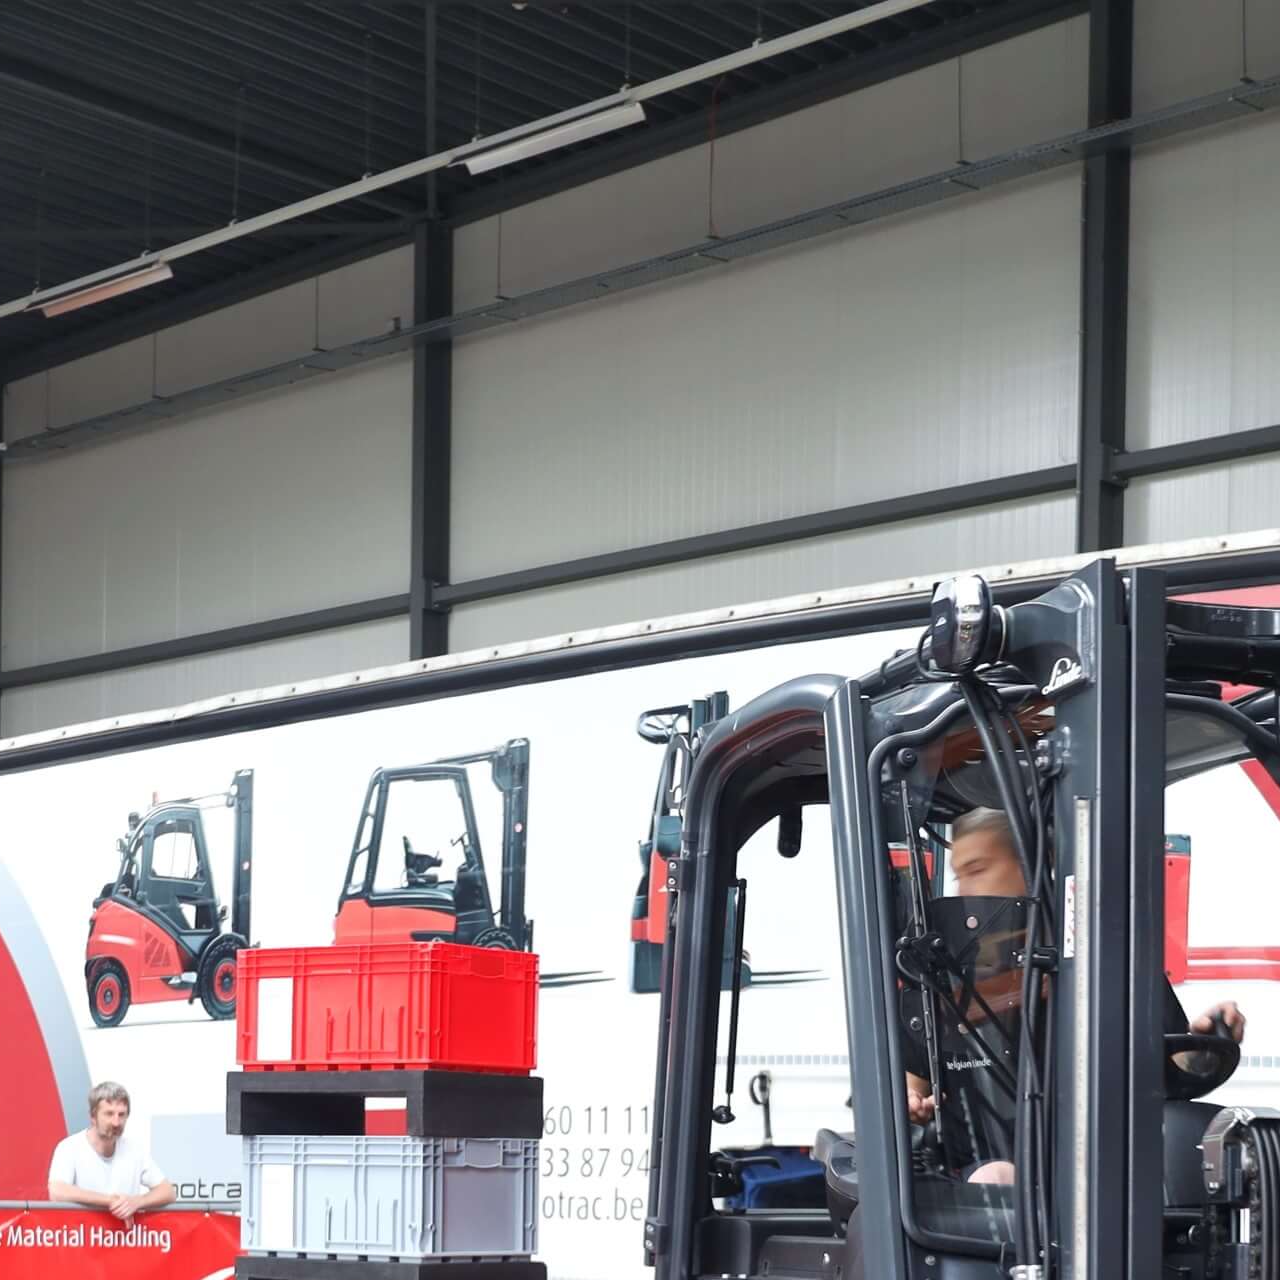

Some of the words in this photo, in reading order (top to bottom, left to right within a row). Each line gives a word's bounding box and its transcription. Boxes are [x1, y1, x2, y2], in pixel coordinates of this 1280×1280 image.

[544, 1105, 572, 1135] 60
[584, 1105, 608, 1135] 11
[624, 1105, 648, 1135] 11
[542, 1147, 569, 1177] 33
[580, 1147, 610, 1177] 87
[620, 1147, 651, 1177] 94
[172, 1177, 242, 1199] otra
[542, 1187, 644, 1221] otrac.be
[7, 1224, 84, 1247] Material
[90, 1224, 171, 1253] Handling
